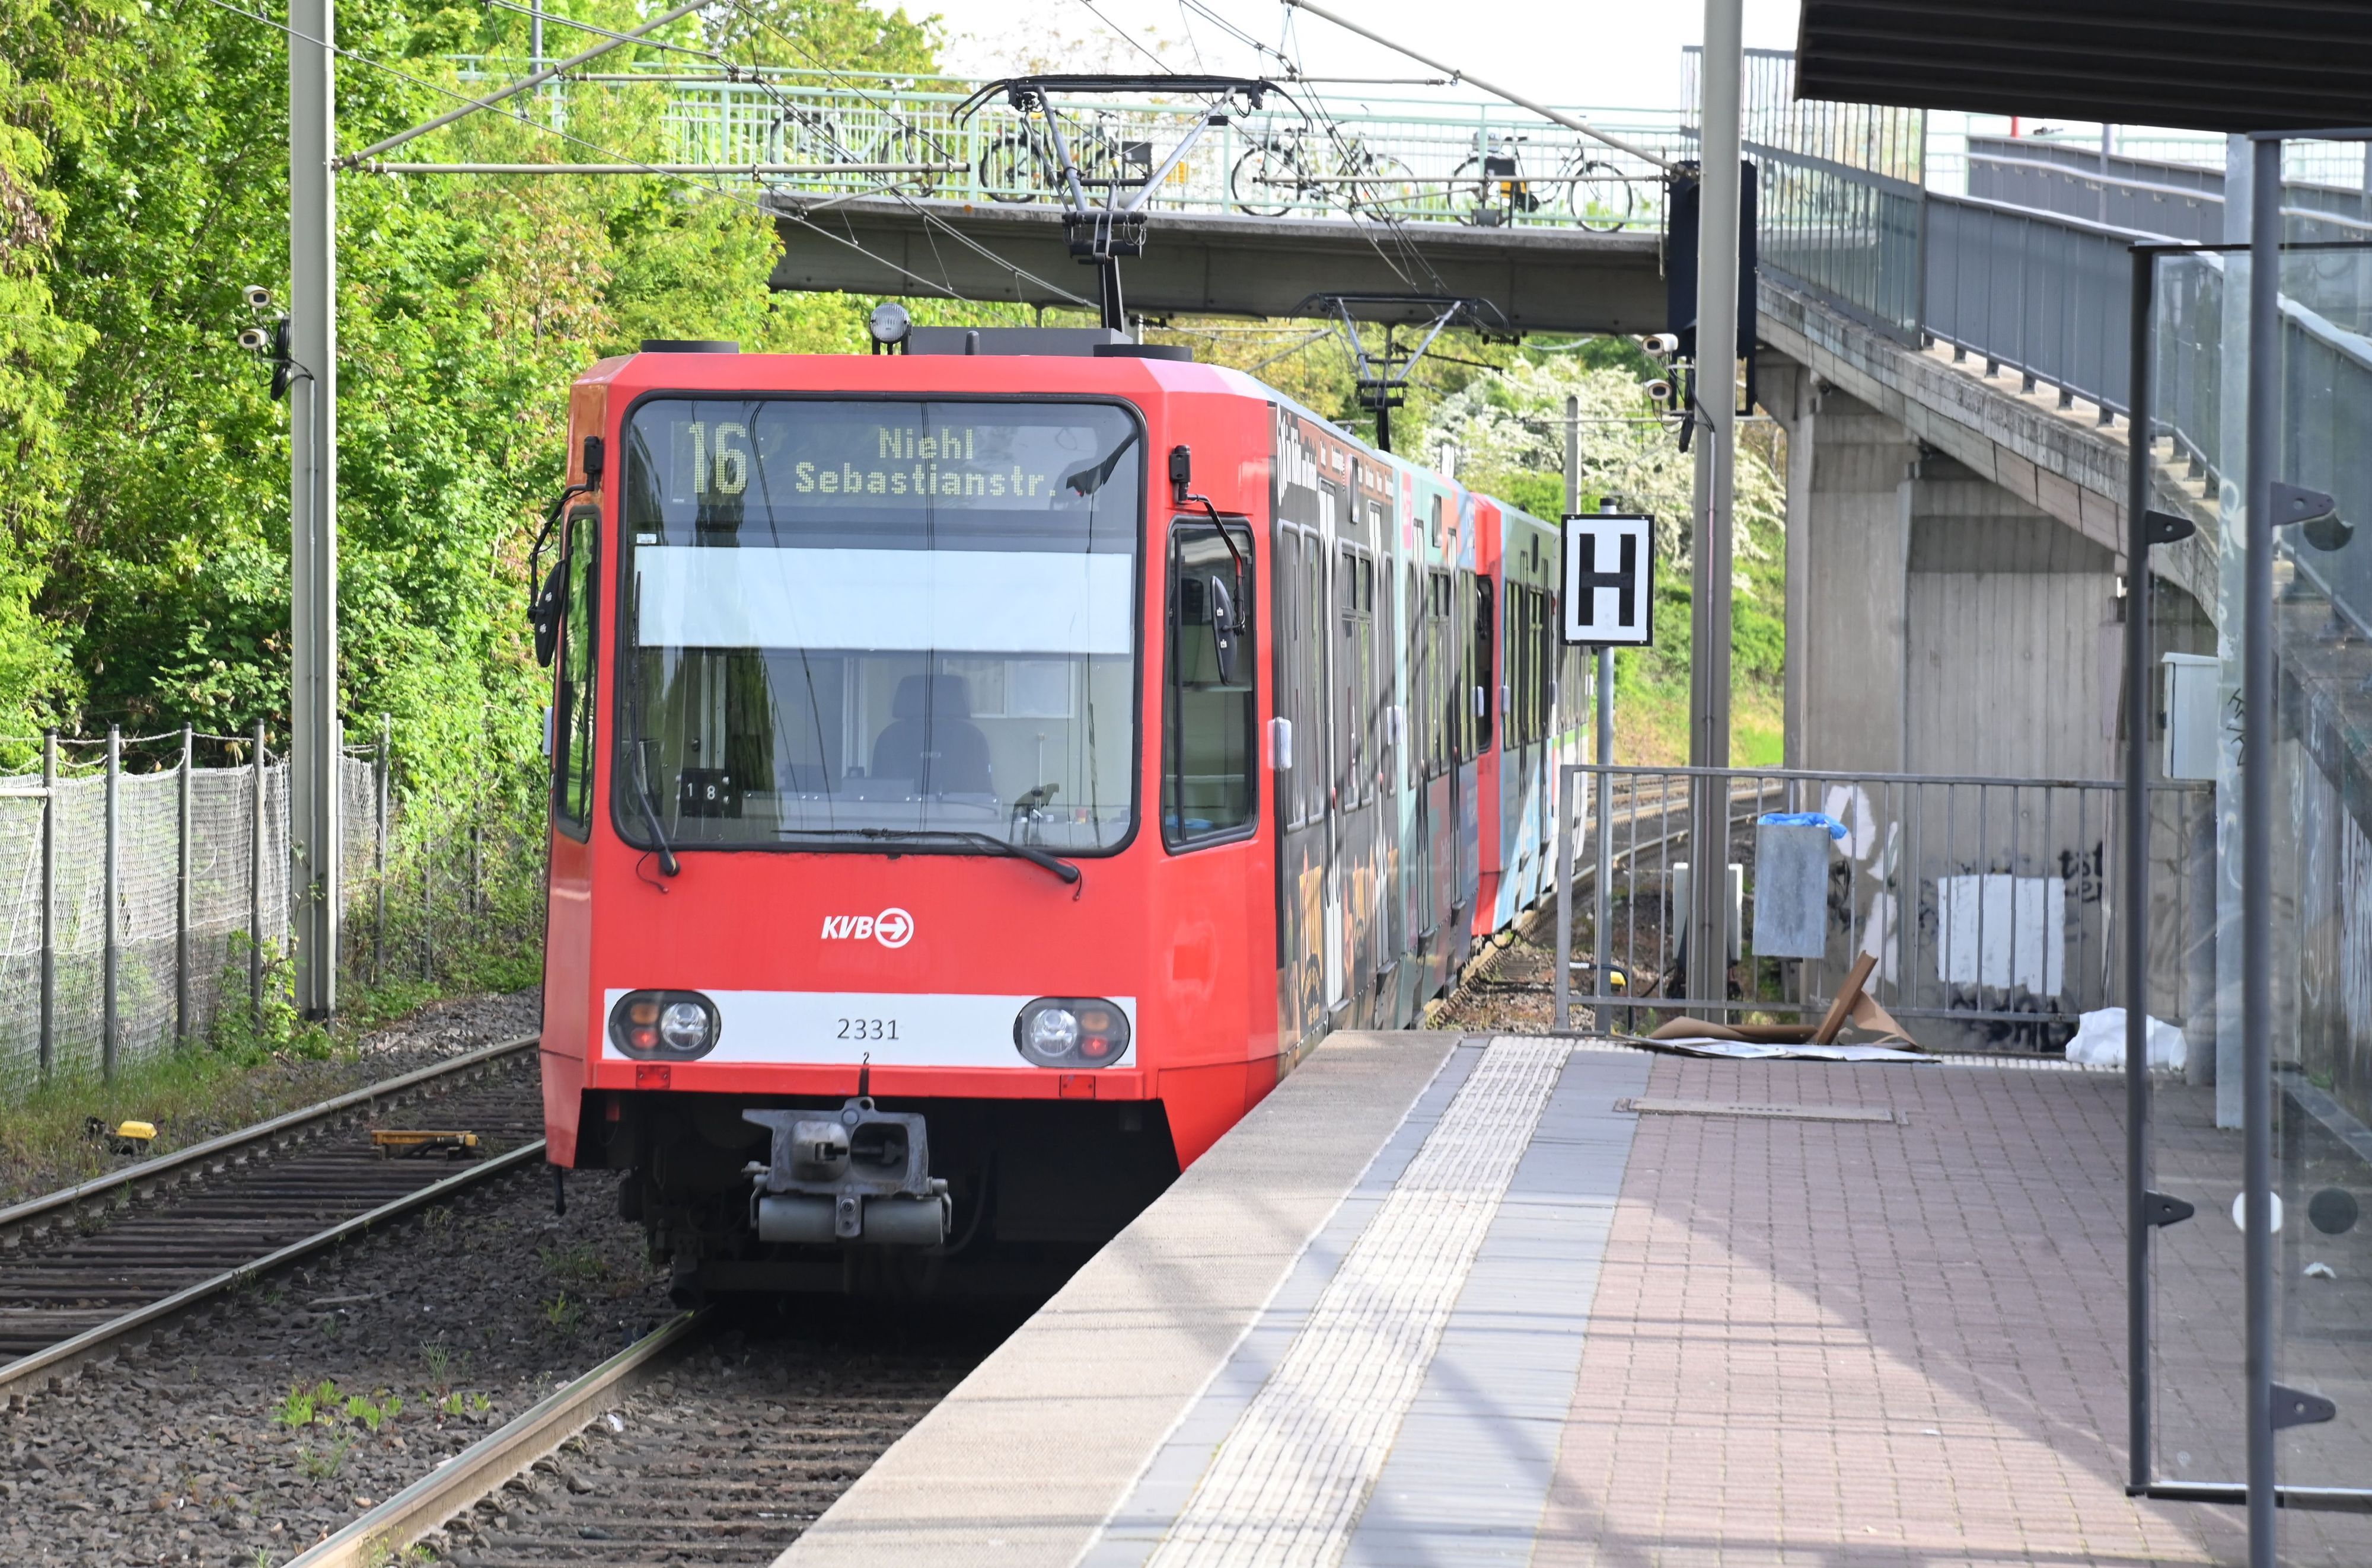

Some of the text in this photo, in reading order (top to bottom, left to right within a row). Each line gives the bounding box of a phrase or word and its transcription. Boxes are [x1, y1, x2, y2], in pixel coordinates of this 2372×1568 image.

[688, 421, 746, 495] 16
[879, 427, 973, 459] Niehl
[795, 461, 1056, 497] Sebastianstr.
[1577, 533, 1637, 627] H
[821, 915, 874, 940] KVB
[837, 1018, 900, 1040] 2331
[862, 1050, 871, 1066] 2
